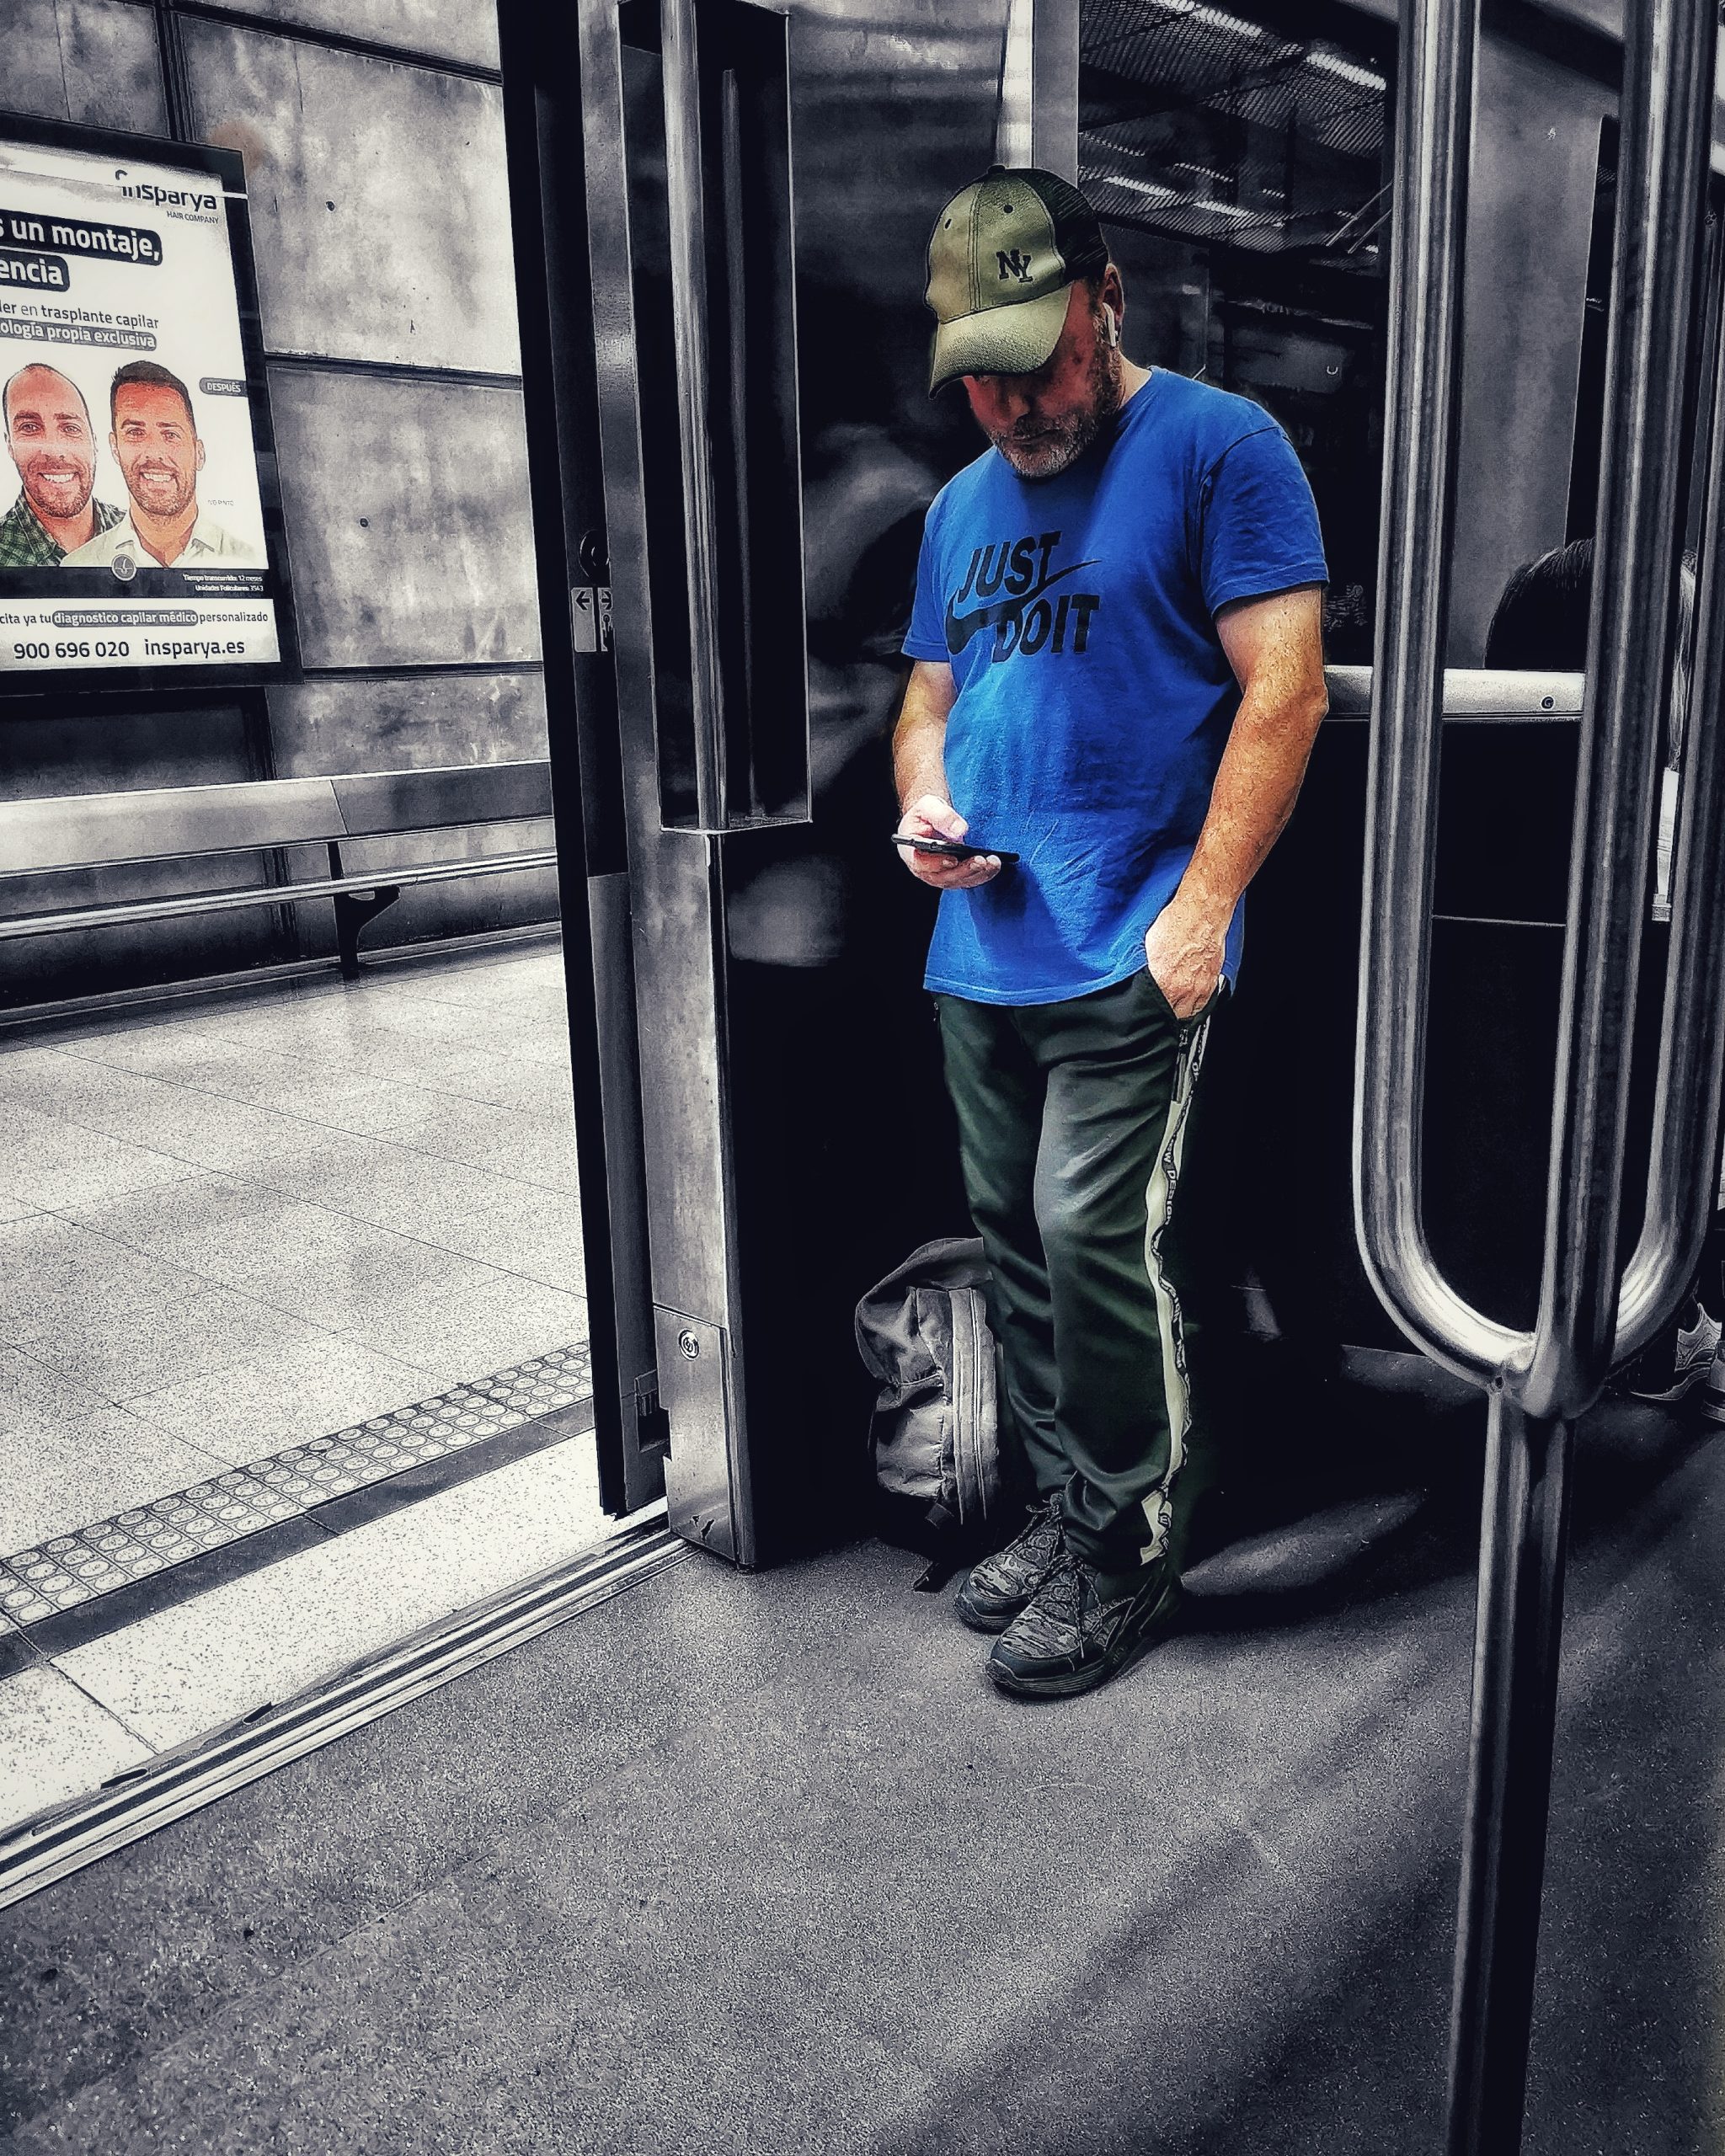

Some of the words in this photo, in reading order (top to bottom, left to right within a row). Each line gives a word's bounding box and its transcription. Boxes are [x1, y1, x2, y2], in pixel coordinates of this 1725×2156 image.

[115, 170, 217, 212] insparya
[167, 211, 184, 220] HAIR
[184, 213, 219, 224] COMPANY
[11, 219, 45, 243] un
[51, 225, 160, 261] montaje,
[996, 248, 1033, 283] NY
[21, 305, 38, 317] en
[41, 304, 113, 324] trasplante
[116, 313, 159, 330] capilar
[47, 326, 92, 344] propia
[94, 330, 156, 348] exclusiva
[206, 382, 242, 393] DESPUÉS
[957, 531, 1061, 603] JUST
[0, 613, 20, 624] cita
[23, 615, 37, 627] ya
[40, 614, 51, 624] tu
[120, 611, 157, 626] capilar
[158, 611, 198, 623] médico
[200, 611, 269, 625] personalizado
[13, 643, 50, 659] 900
[55, 642, 90, 659] 696
[95, 641, 130, 658] 020
[144, 638, 245, 659] insparya.es
